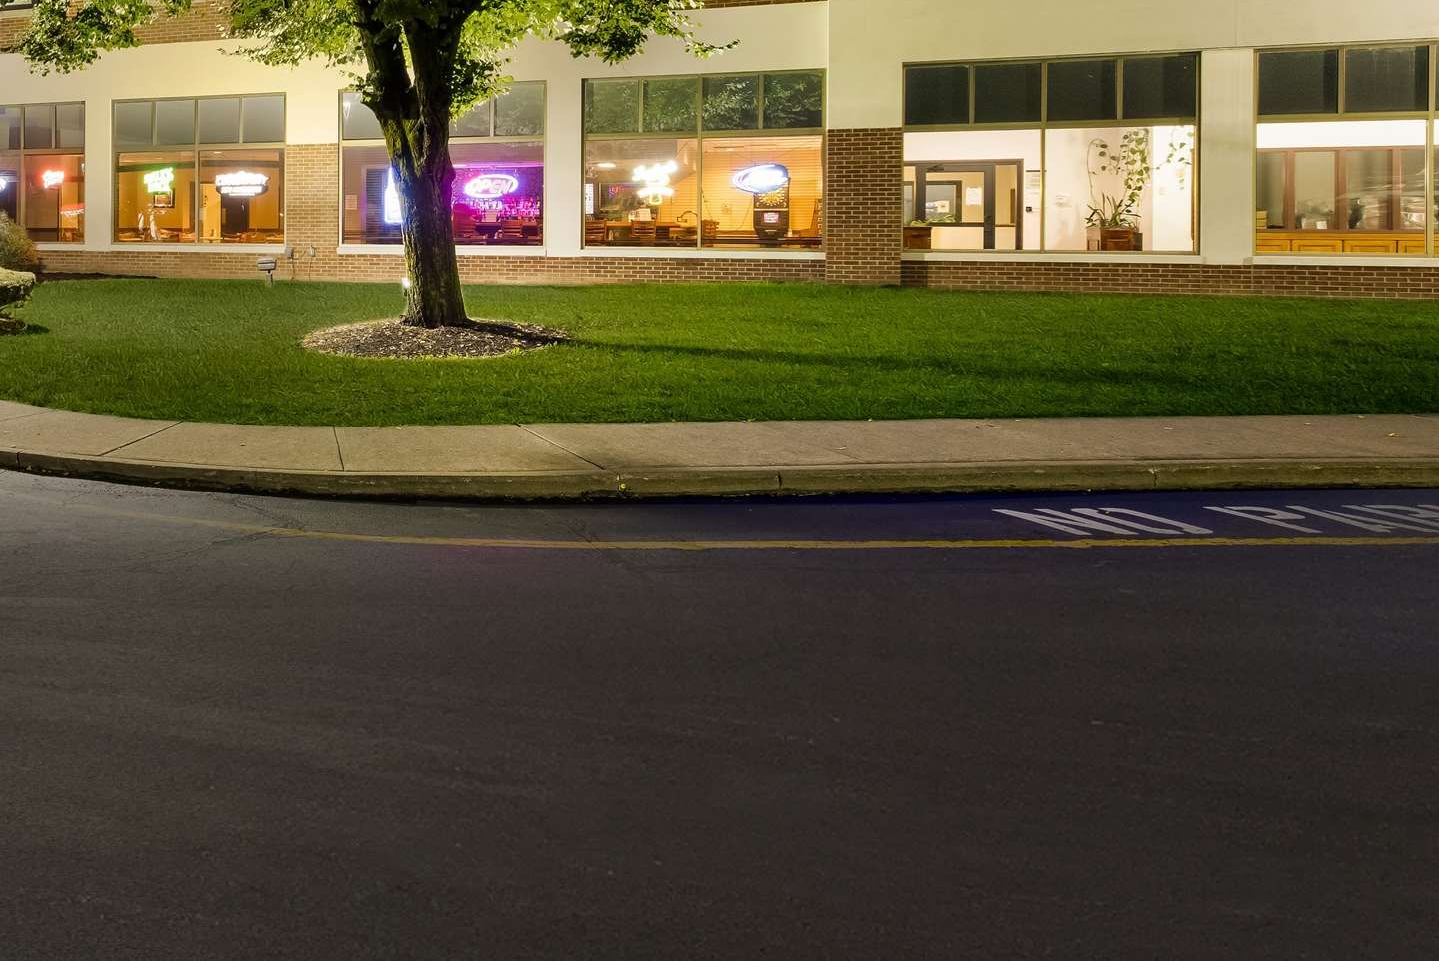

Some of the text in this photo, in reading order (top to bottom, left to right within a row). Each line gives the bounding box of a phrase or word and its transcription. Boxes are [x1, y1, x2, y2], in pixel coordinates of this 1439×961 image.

[470, 177, 515, 195] OPEN
[992, 504, 1439, 536] NO PAR
